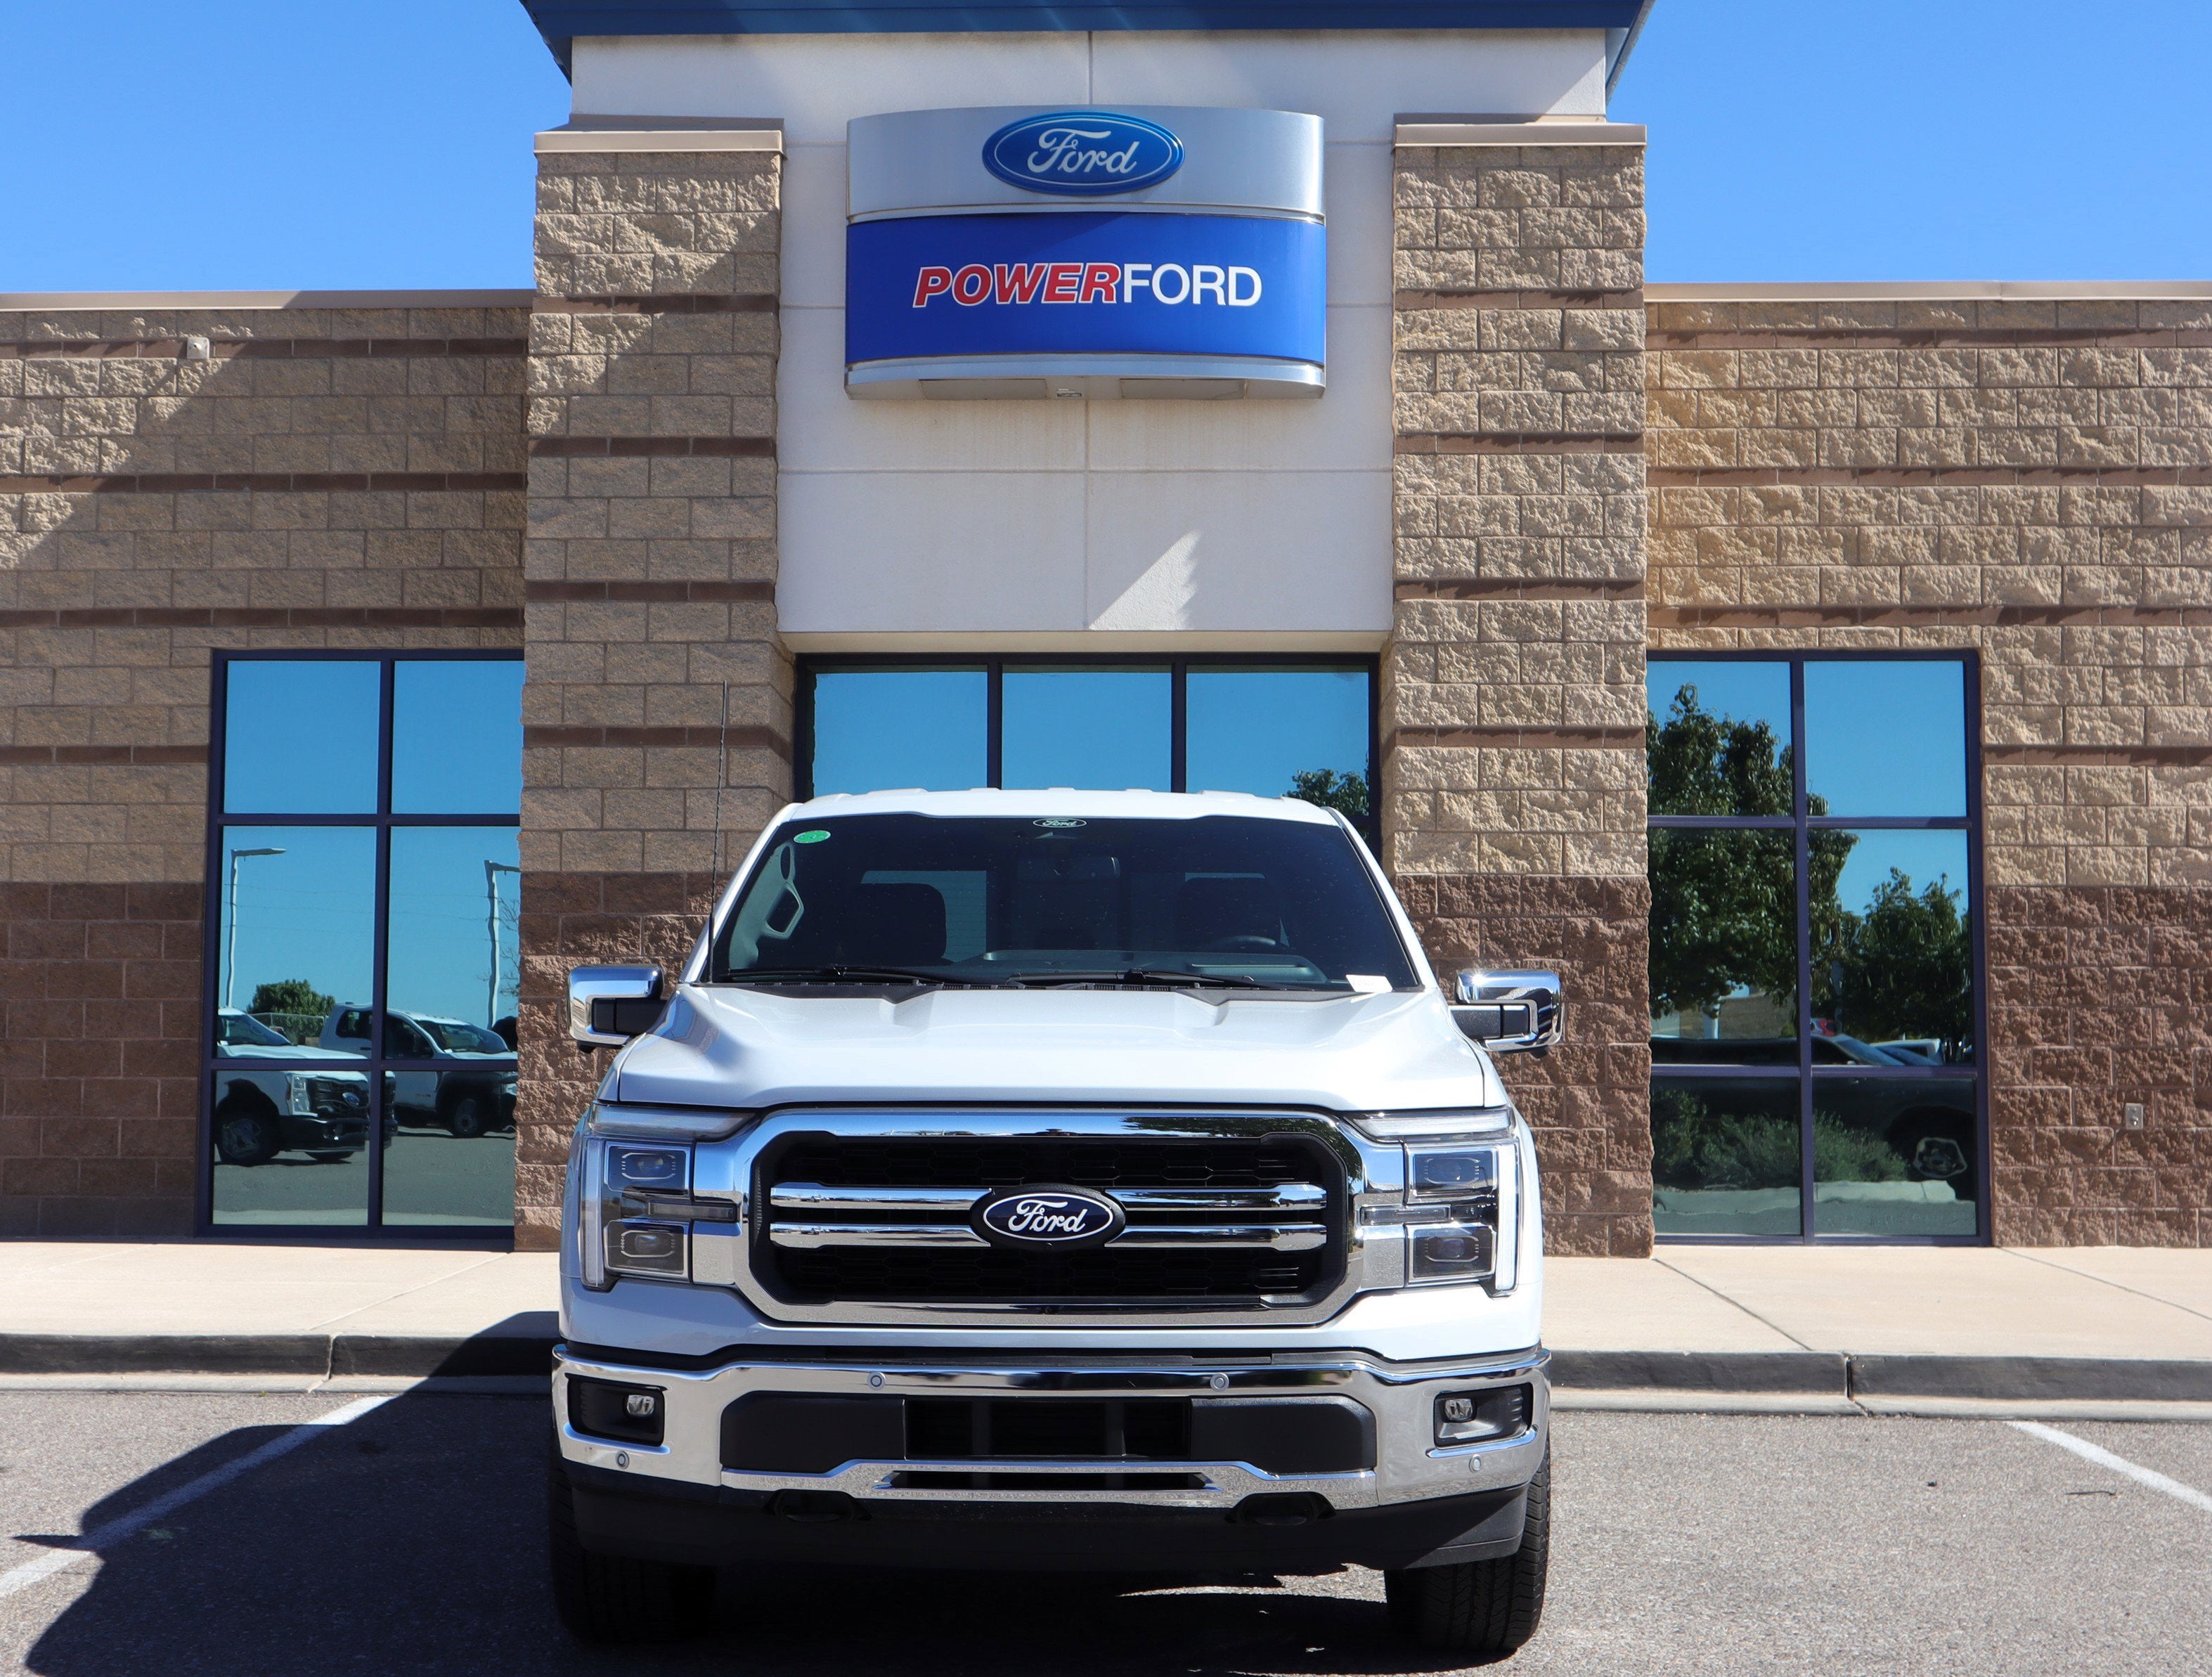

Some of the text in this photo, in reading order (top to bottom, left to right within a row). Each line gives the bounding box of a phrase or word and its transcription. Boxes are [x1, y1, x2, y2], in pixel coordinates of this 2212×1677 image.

[1027, 128, 1138, 174] Ford
[912, 262, 1262, 308] POWERFORD
[1008, 1199, 1087, 1233] Ford
